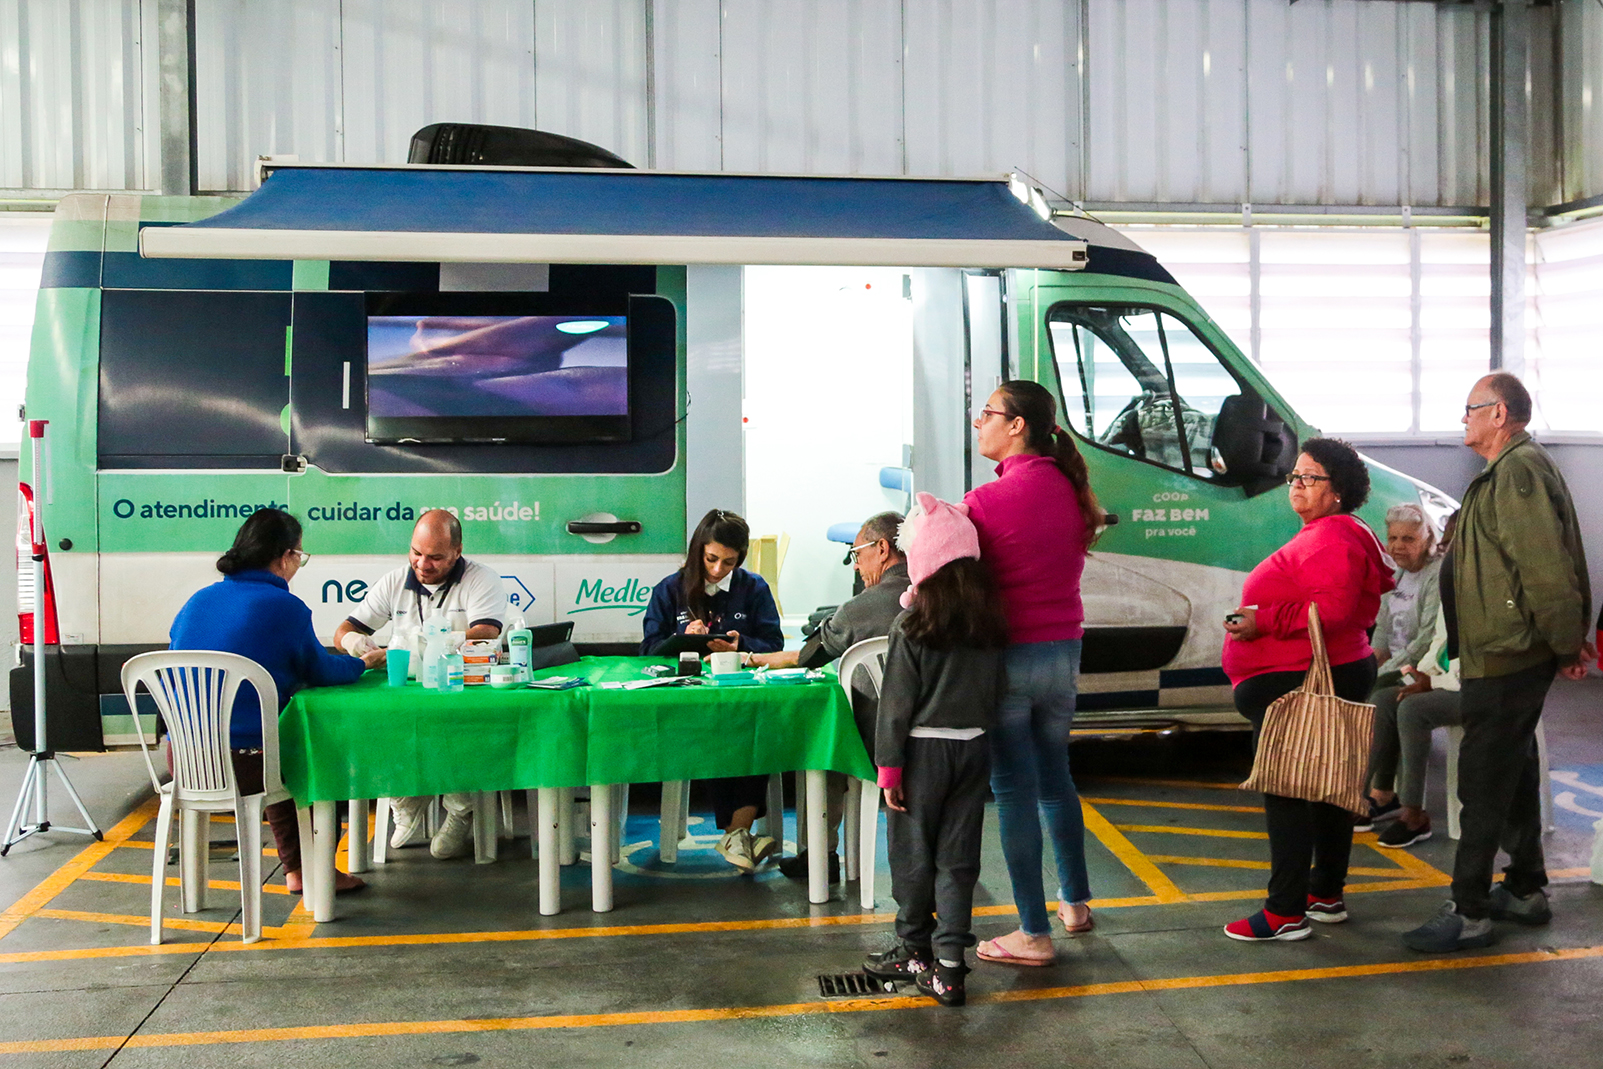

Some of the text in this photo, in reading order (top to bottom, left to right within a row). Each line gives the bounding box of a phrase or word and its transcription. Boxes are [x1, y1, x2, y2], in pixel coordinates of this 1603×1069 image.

[113, 498, 135, 519] O
[307, 501, 381, 521] cuidar
[386, 501, 414, 521] da
[463, 501, 541, 521] saúde!
[1146, 525, 1197, 539] pra você
[575, 578, 654, 605] Medle
